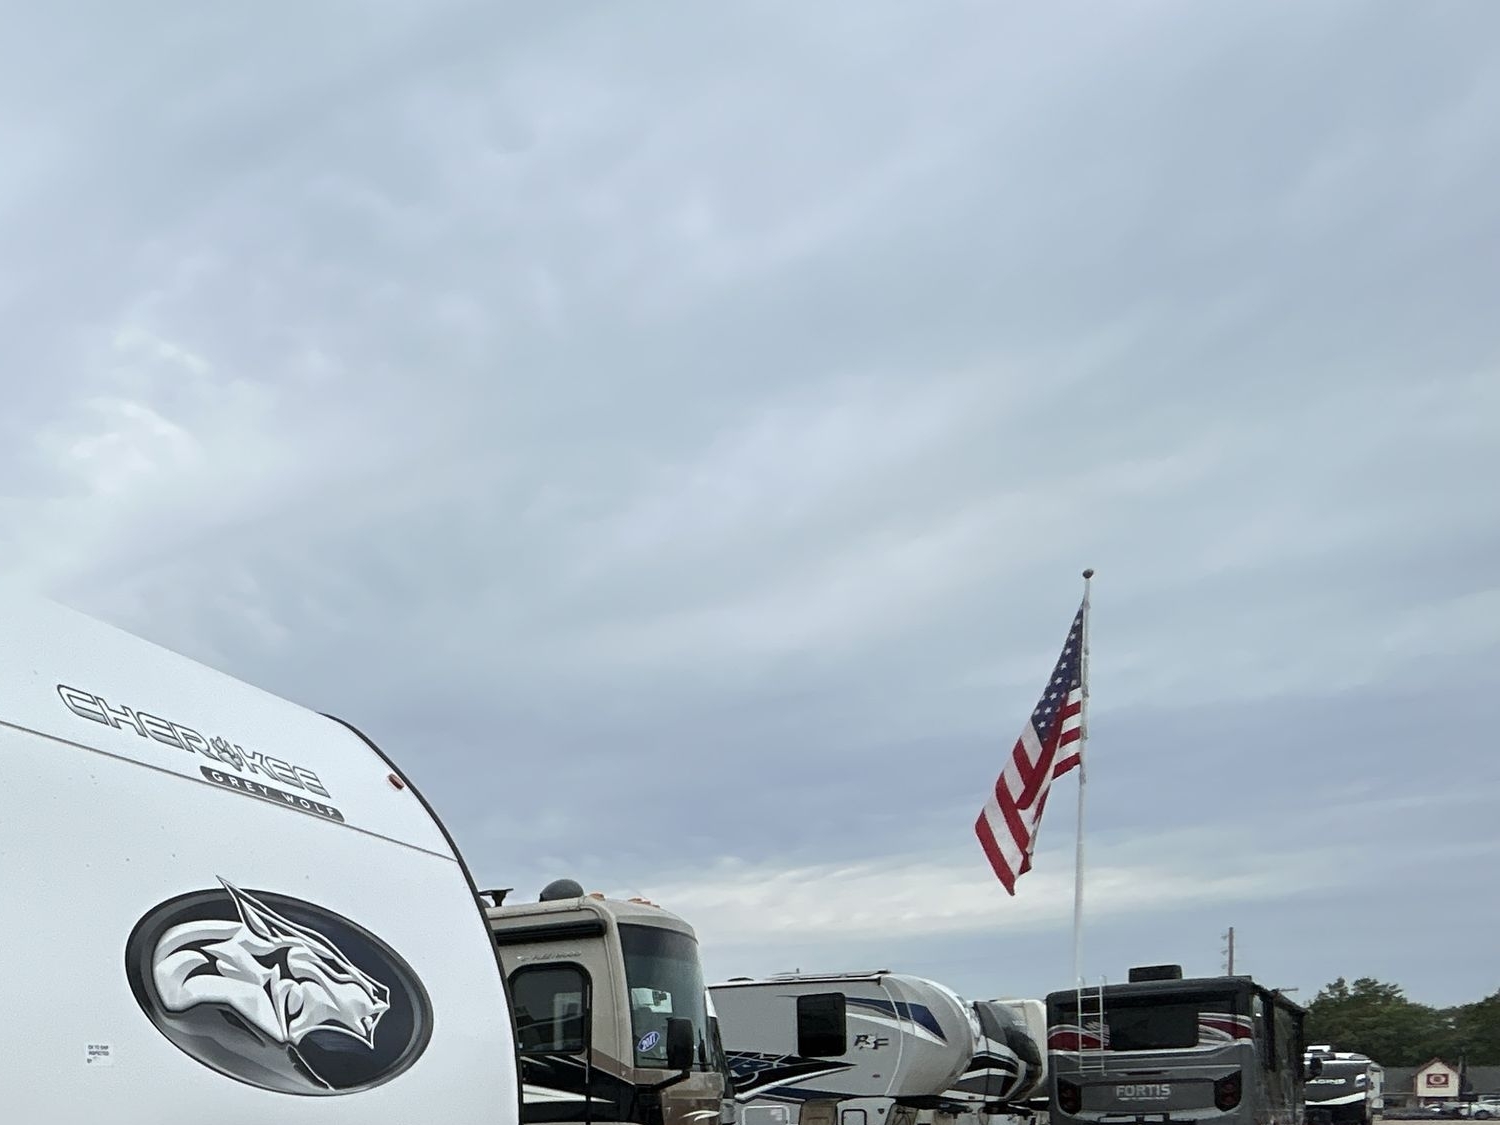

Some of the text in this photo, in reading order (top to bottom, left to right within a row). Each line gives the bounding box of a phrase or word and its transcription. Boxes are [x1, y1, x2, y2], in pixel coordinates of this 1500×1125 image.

[211, 771, 334, 817] GREY WOLF
[1116, 1084, 1171, 1097] FORTIS
